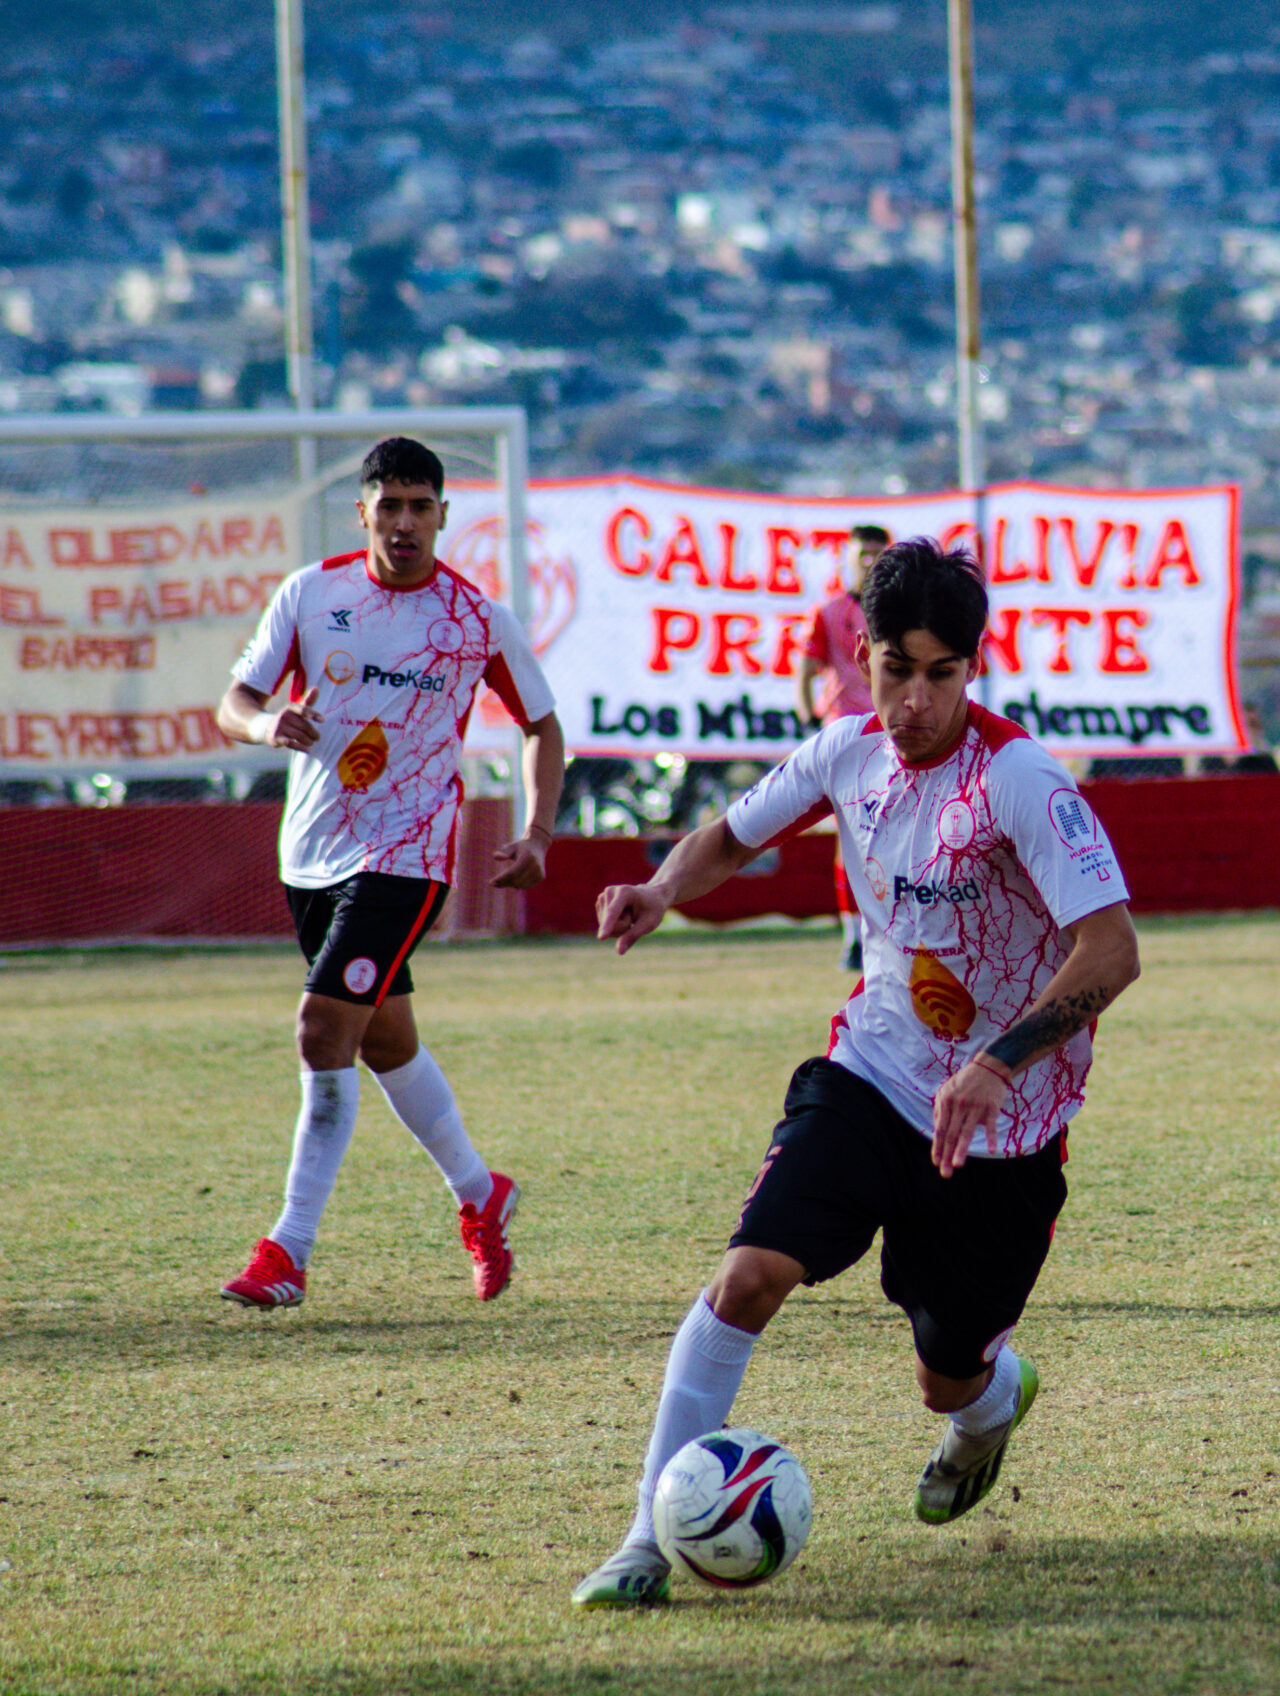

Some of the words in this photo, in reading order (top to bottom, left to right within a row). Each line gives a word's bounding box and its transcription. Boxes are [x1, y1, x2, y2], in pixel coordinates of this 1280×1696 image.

[3, 528, 34, 571] A
[47, 515, 288, 568] QUEDARA
[604, 506, 852, 596] CALET
[0, 582, 65, 626] EL
[19, 633, 157, 671] BARRIO
[648, 606, 1150, 677] PRENTE
[362, 664, 446, 692] PreKad
[589, 695, 680, 738] Los
[1003, 691, 1213, 744] siempre
[894, 875, 982, 905] PreKad
